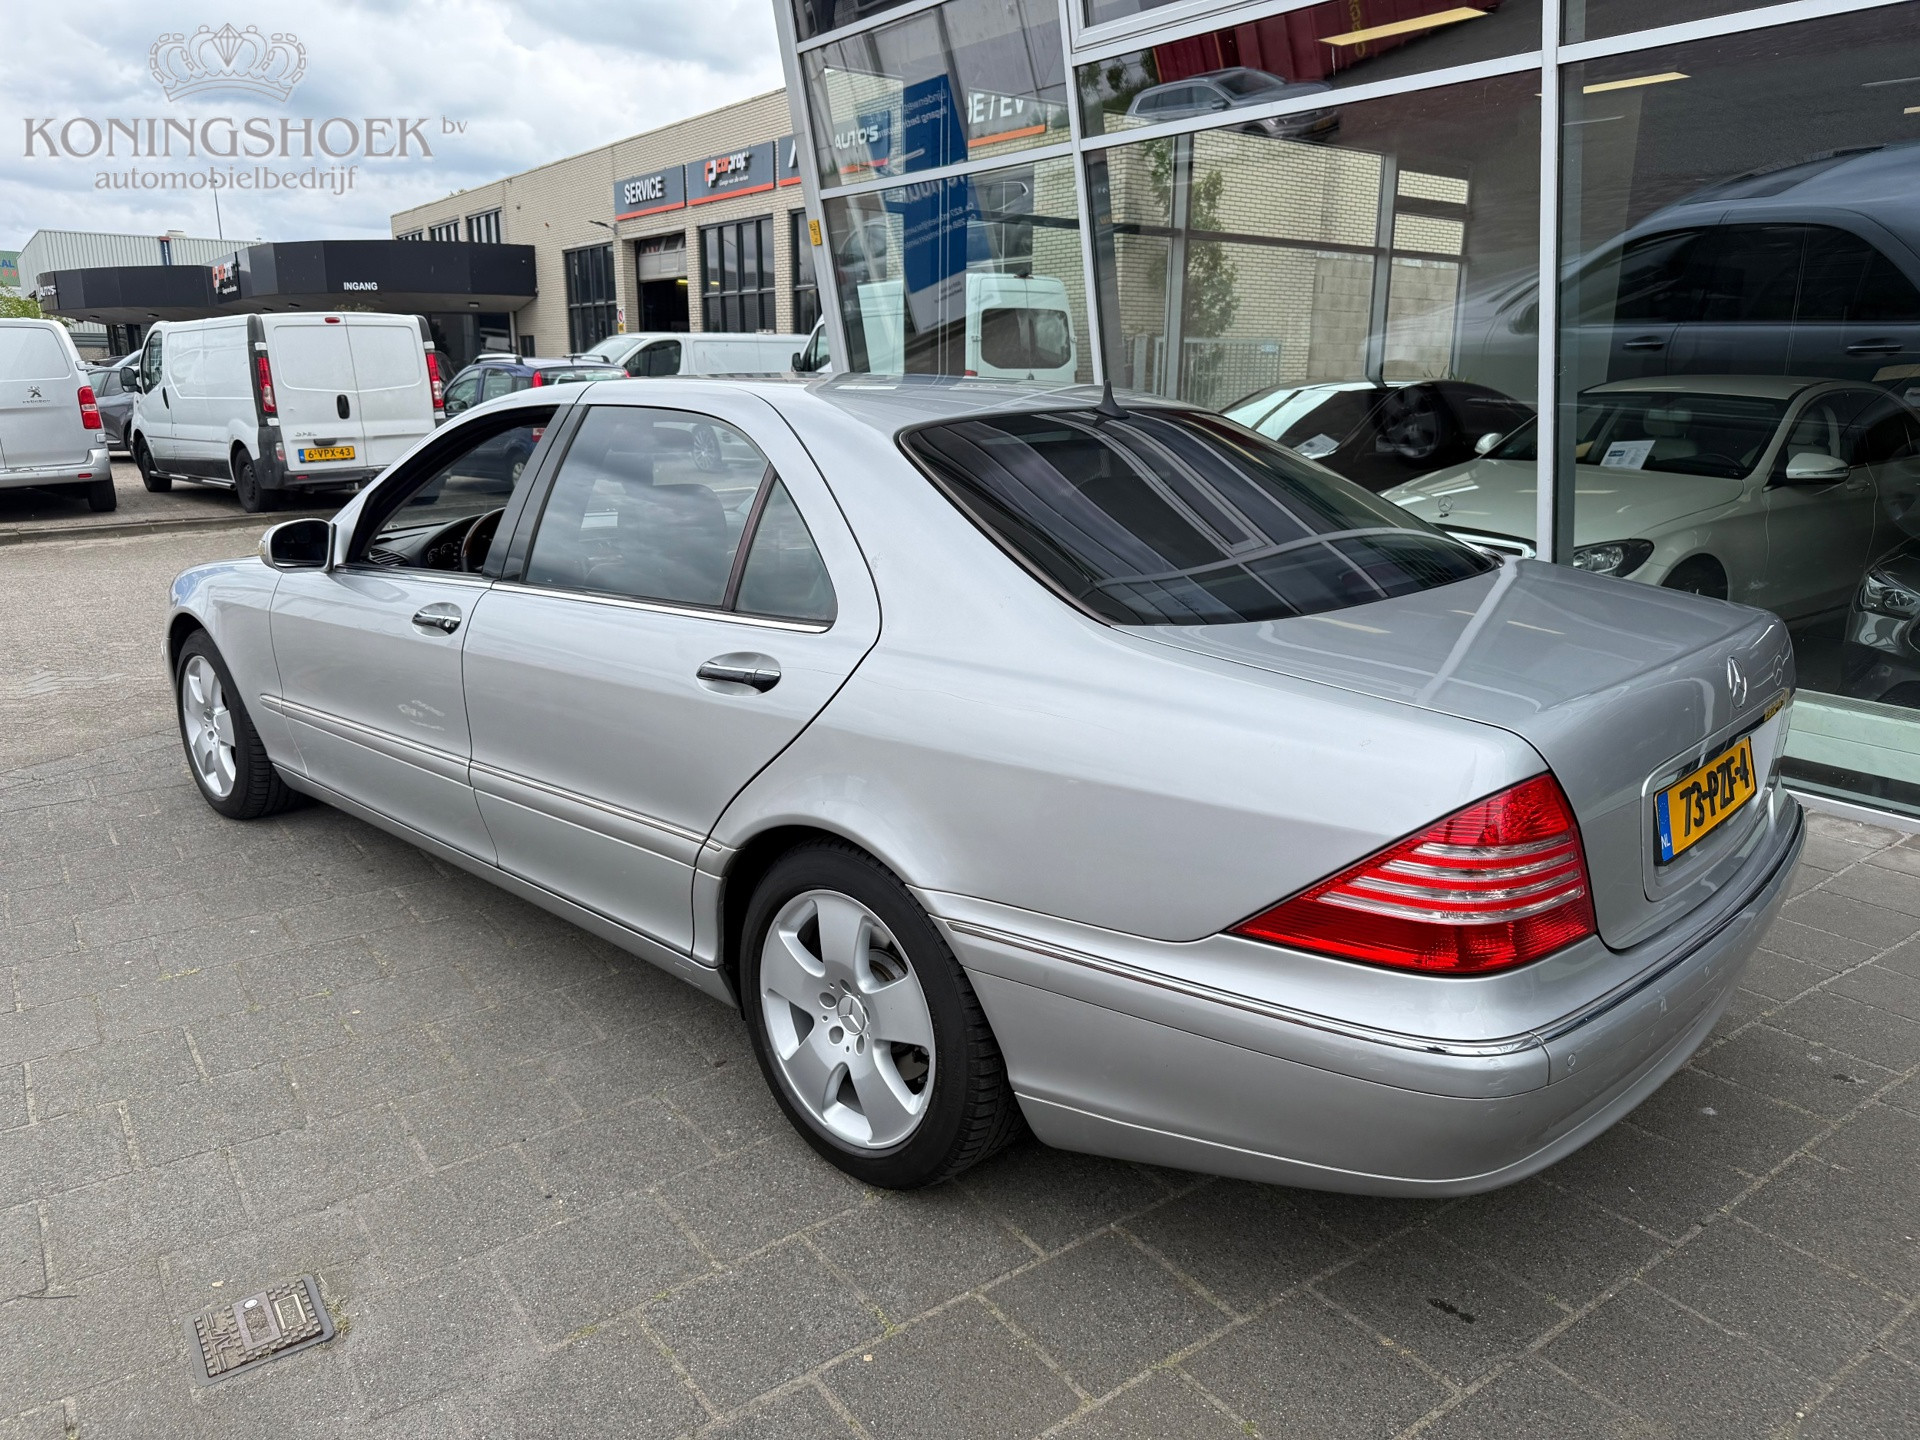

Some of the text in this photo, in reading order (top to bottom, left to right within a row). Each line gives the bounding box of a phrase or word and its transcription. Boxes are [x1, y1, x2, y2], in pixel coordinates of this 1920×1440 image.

[624, 176, 662, 205] SERVICE
[343, 282, 378, 291] INGANG
[1661, 833, 1671, 849] NL
